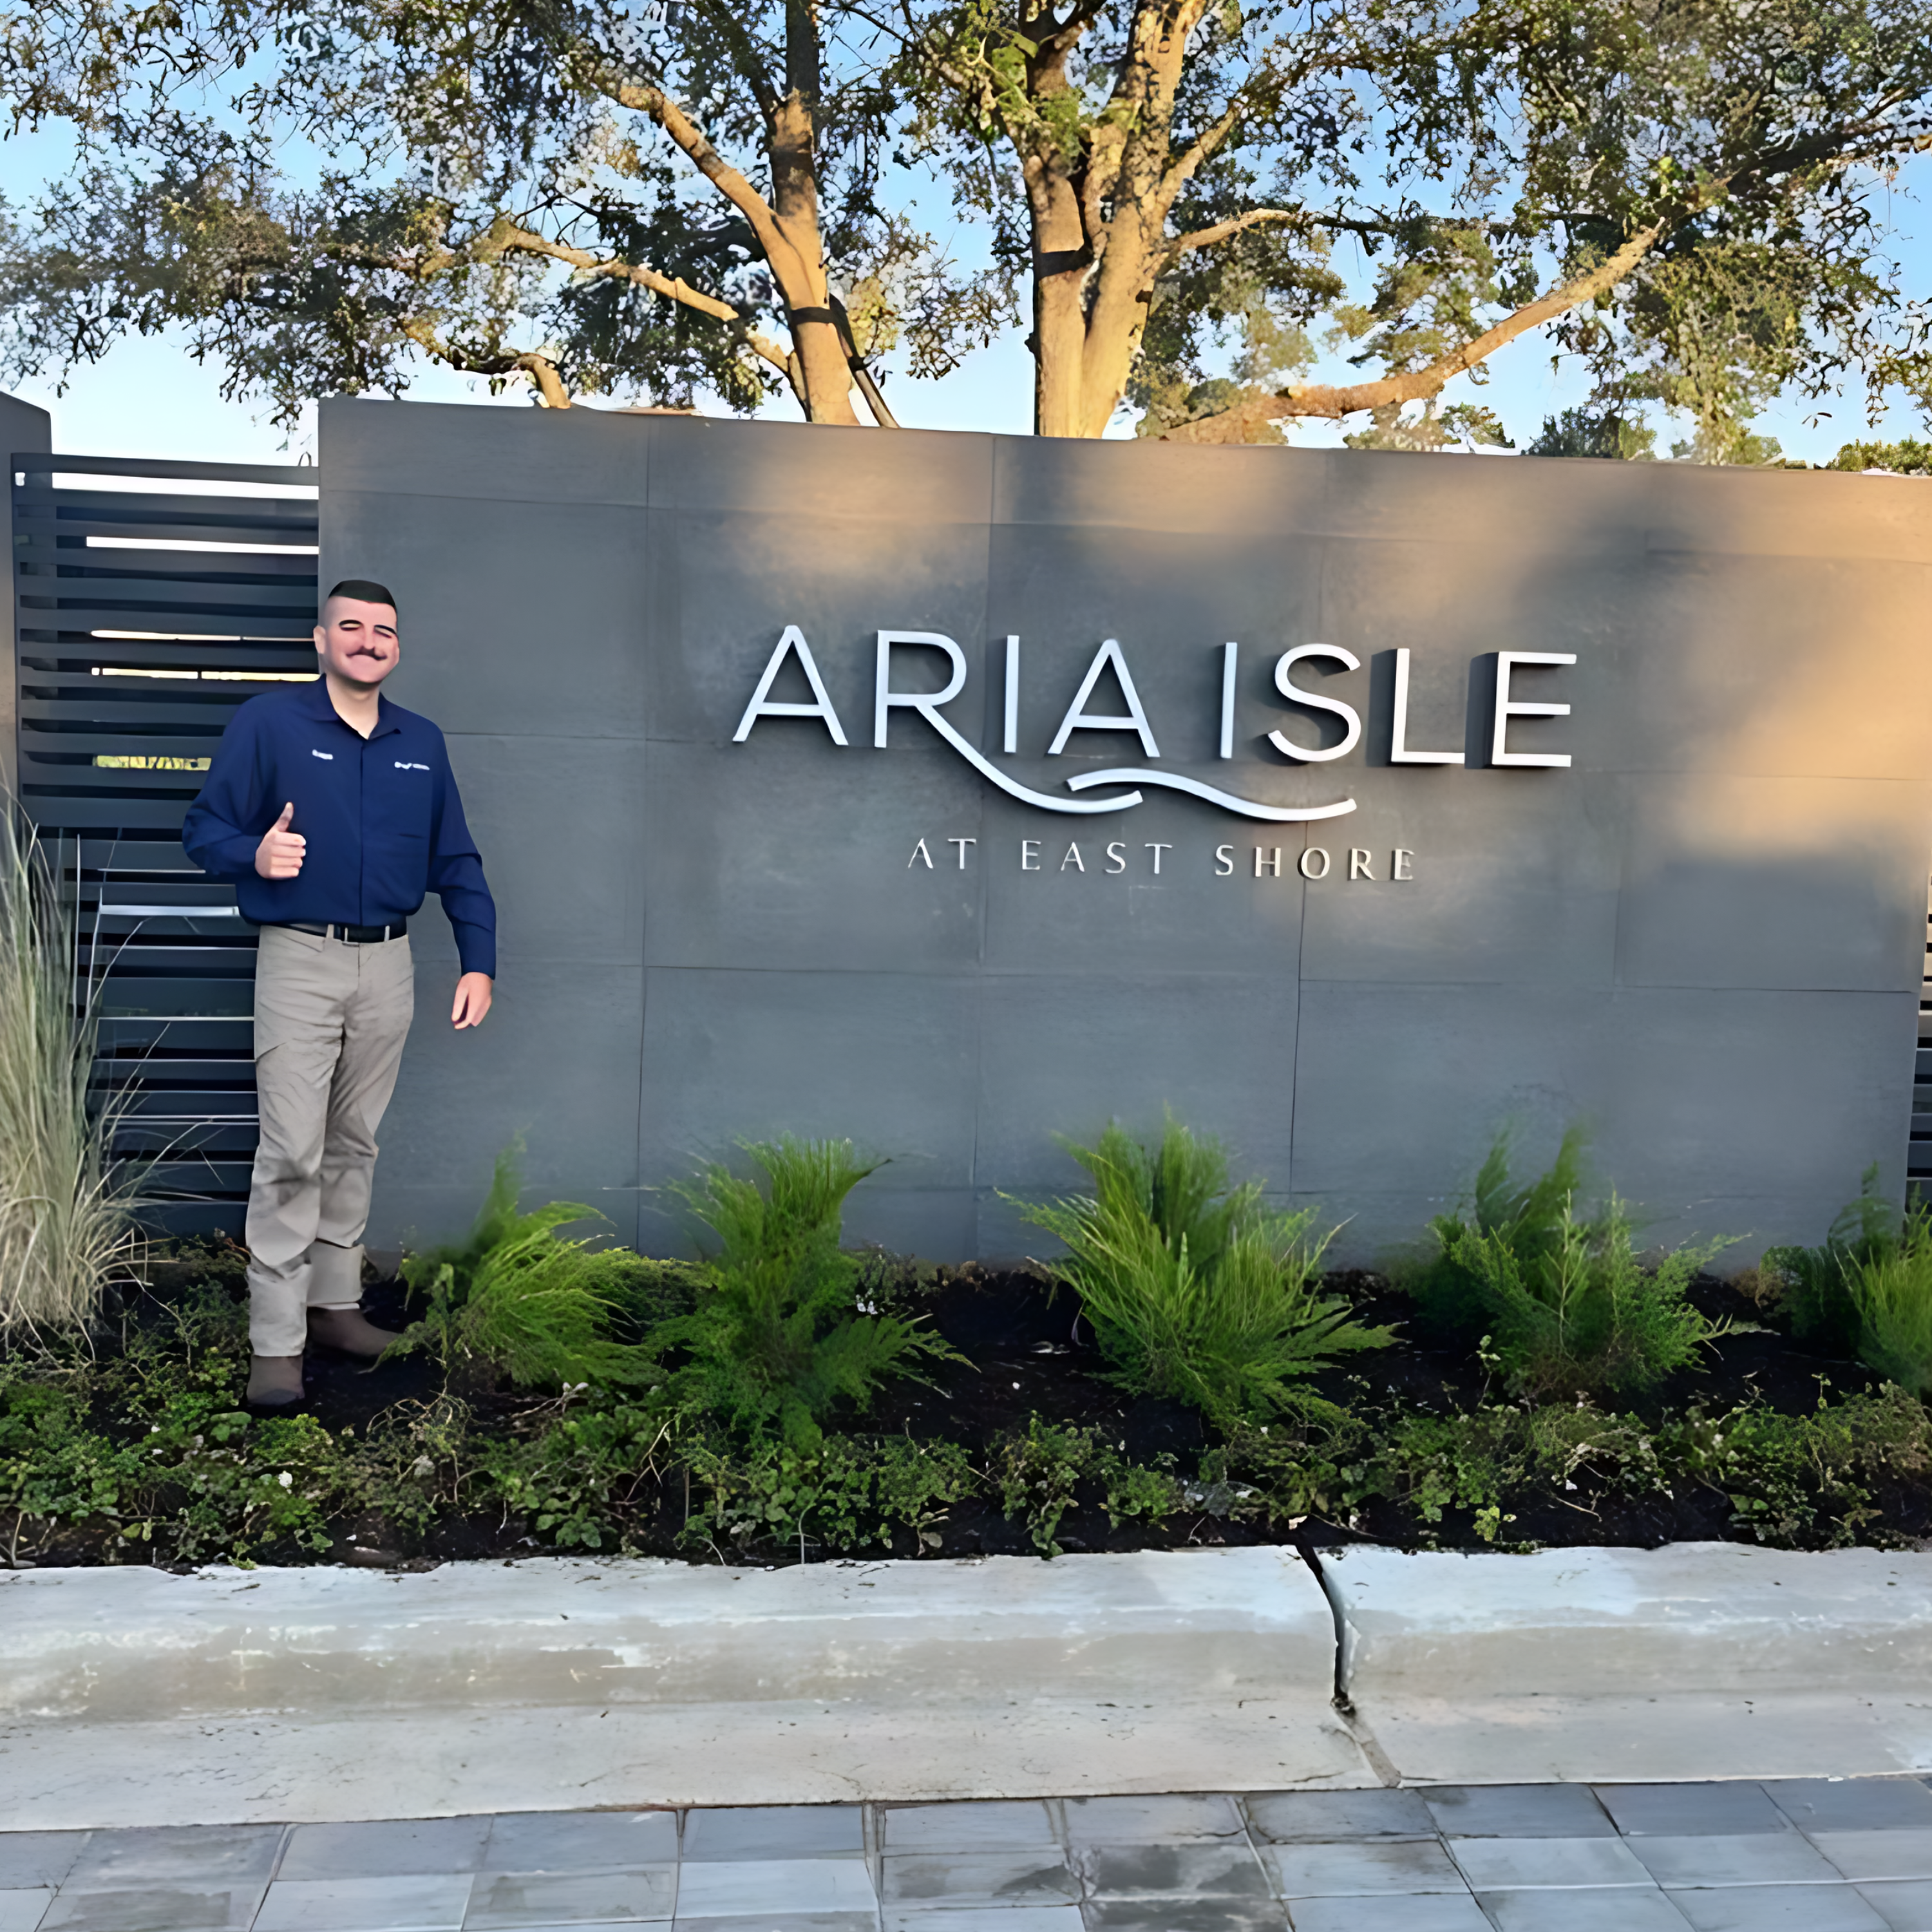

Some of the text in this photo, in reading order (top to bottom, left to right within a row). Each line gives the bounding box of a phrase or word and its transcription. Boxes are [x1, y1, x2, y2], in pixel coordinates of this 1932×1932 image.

[732, 624, 1577, 814] ARIA ISLE
[907, 837, 1416, 882] AT EAST SHORE
